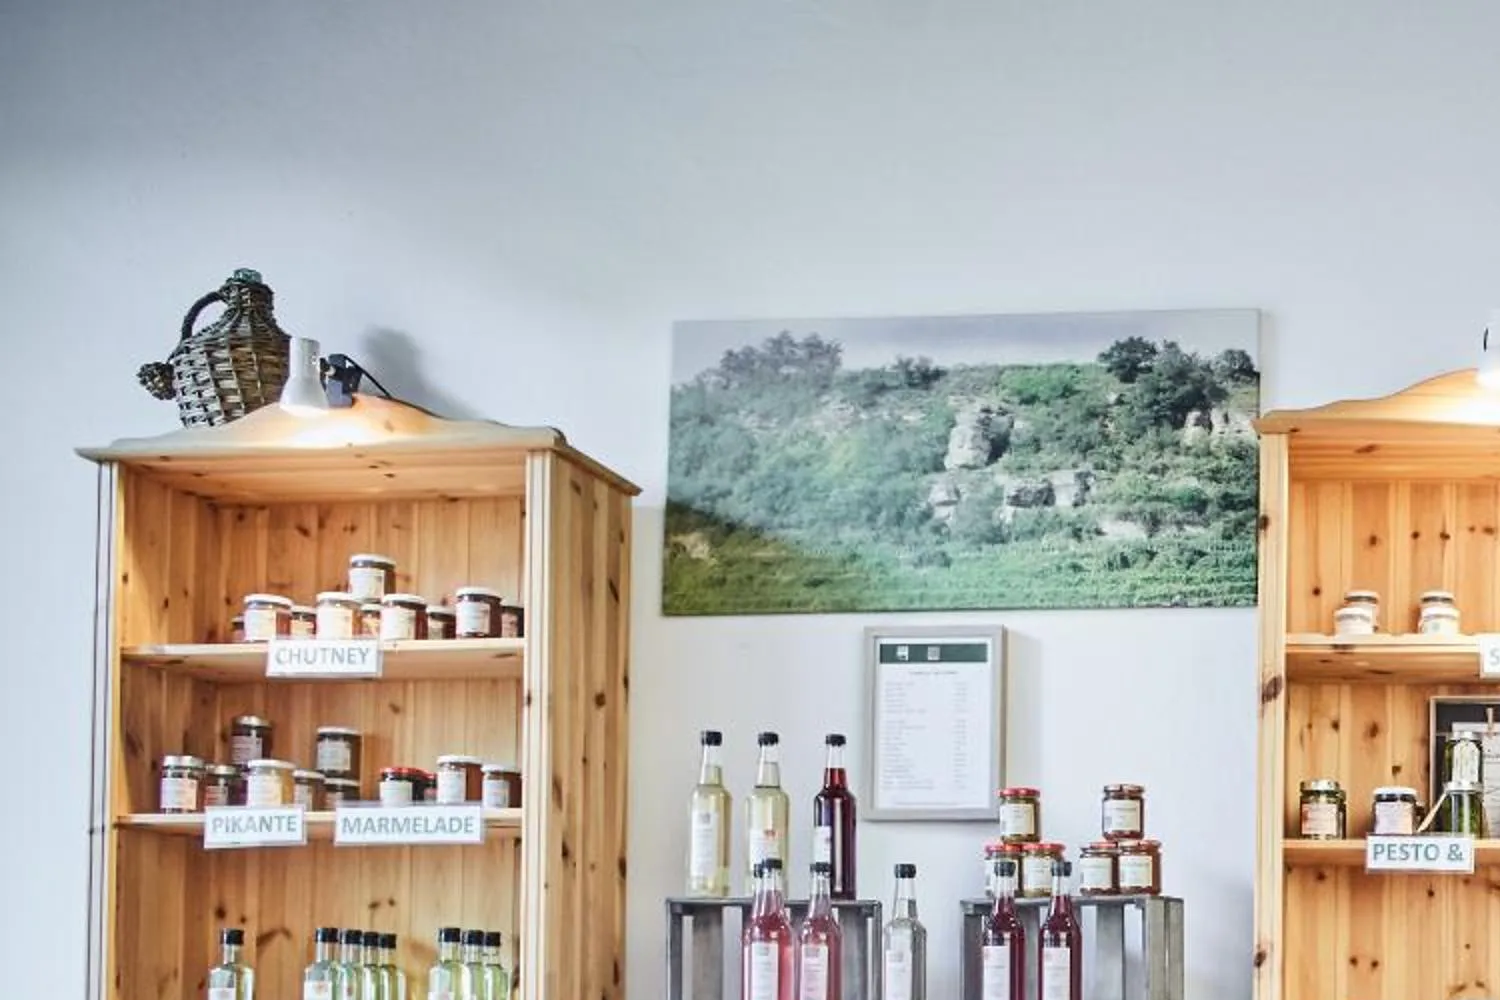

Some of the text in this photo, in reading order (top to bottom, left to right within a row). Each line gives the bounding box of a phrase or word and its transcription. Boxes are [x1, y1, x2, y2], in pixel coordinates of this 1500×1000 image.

[274, 647, 370, 666] CHUTNEY
[210, 814, 298, 834] PIKANTE
[341, 814, 475, 834] MARMELADE
[1371, 842, 1465, 862] PESTO &
